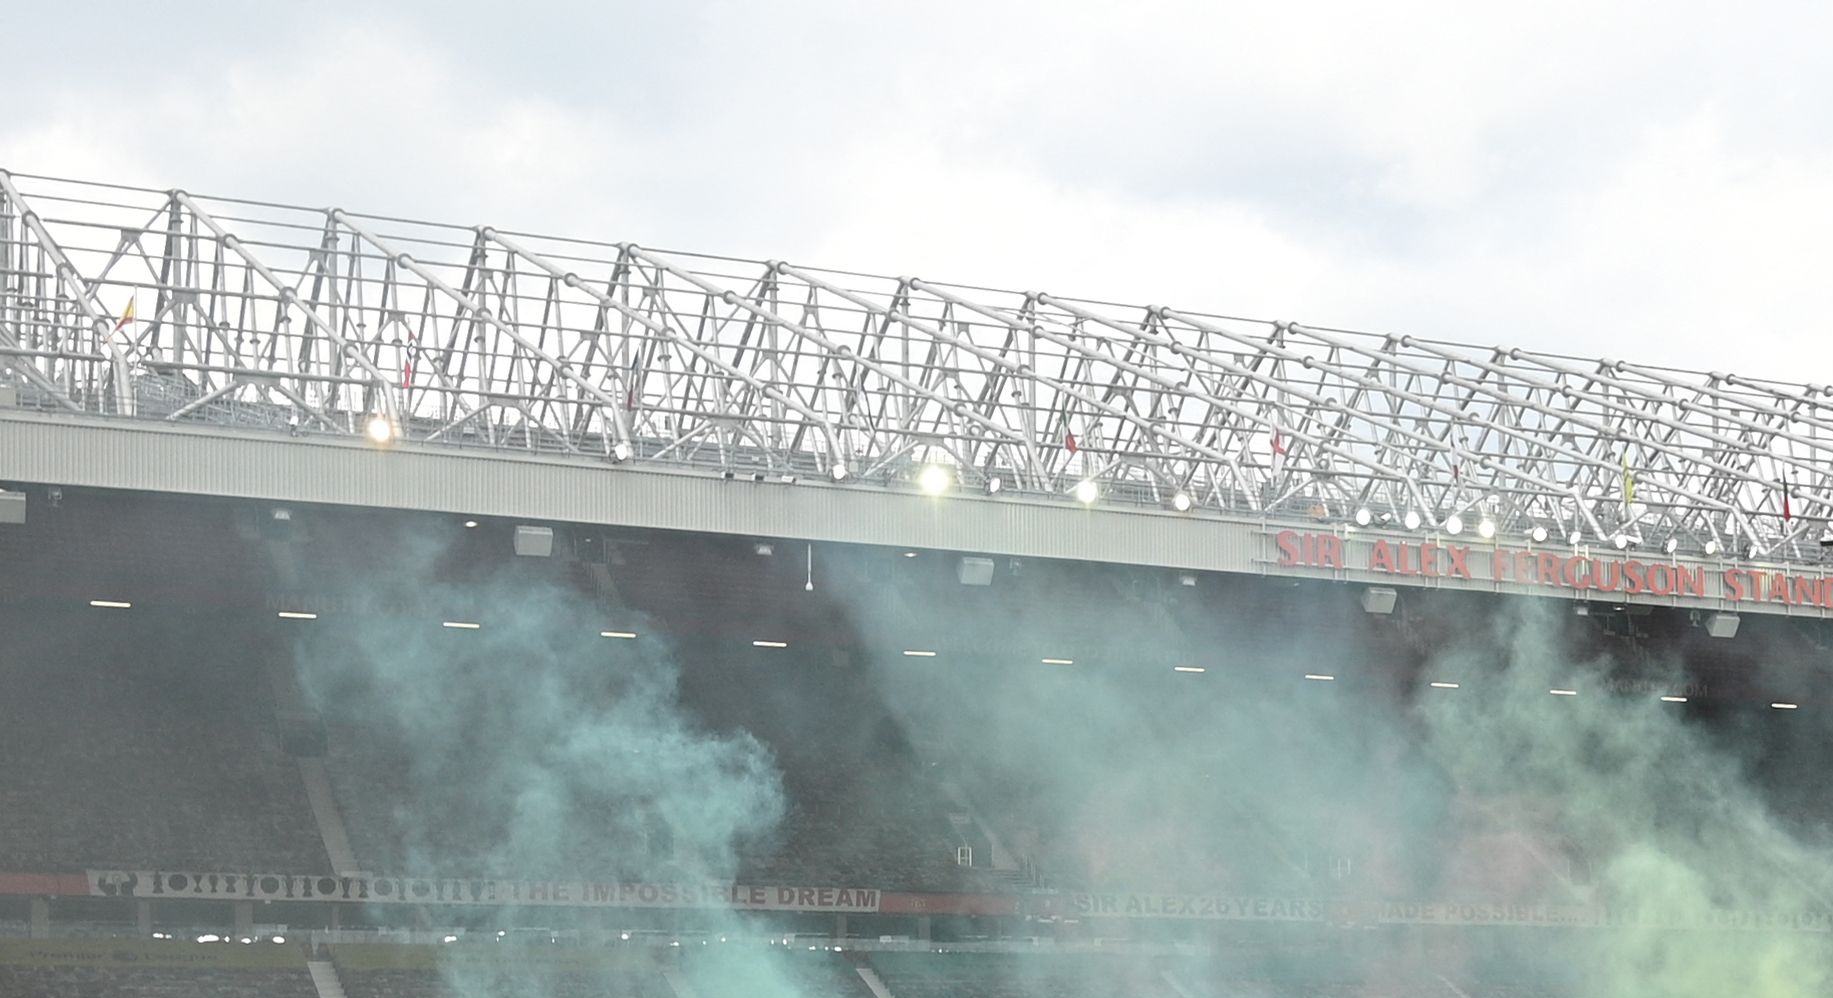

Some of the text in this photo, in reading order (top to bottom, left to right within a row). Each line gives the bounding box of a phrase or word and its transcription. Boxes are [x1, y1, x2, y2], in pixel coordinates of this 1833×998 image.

[1276, 530, 1344, 569] SIR
[1368, 538, 1472, 580] ALEX
[1493, 549, 1703, 598] FERGUSON
[511, 881, 570, 901] THE
[778, 886, 877, 908] DREAM
[1078, 894, 1325, 918] SIR ALEX 26 YEARS
